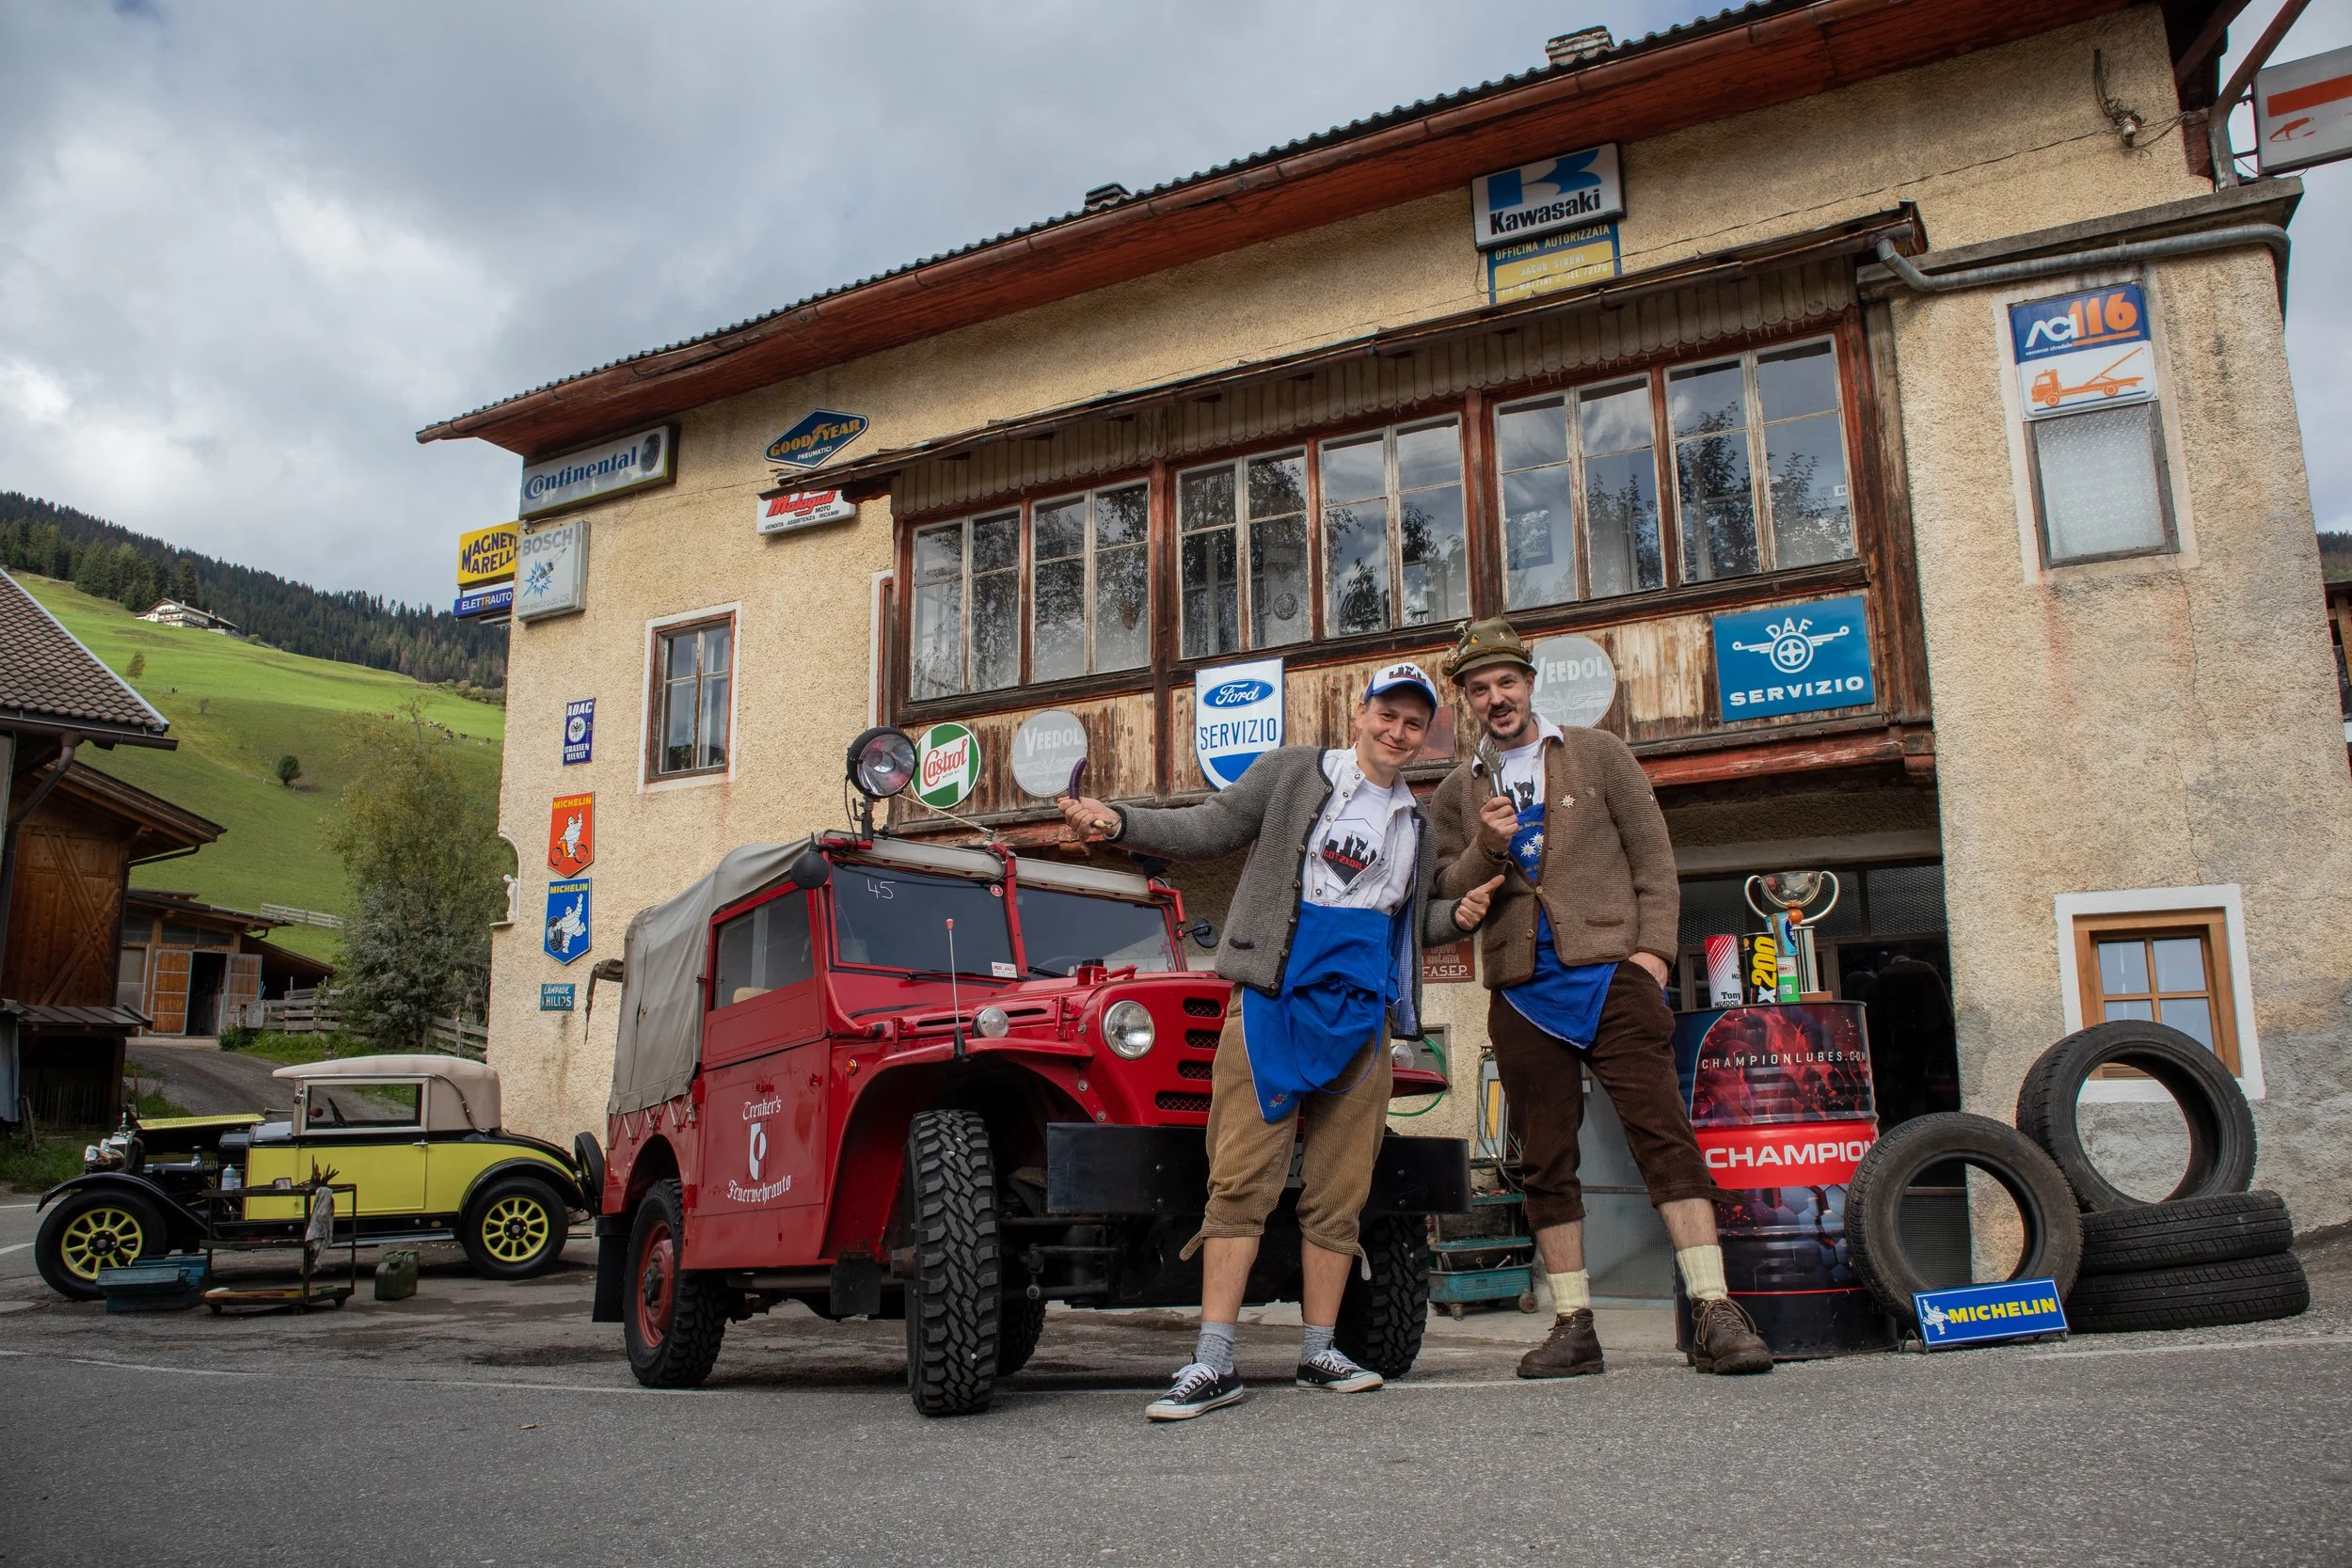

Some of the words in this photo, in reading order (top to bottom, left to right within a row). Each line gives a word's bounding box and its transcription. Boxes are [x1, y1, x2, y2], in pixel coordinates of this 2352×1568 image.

[1490, 188, 1601, 235] Kawasaki
[1495, 242, 1539, 261] OFFICINA
[1544, 224, 1610, 248] AUTORIZZATA
[2068, 292, 2138, 338] 116
[770, 419, 861, 457] GOODYEAR
[797, 446, 833, 461] PNEUMATICI
[524, 446, 637, 500] Continental
[815, 504, 831, 514] MOTO
[765, 521, 785, 531] VENDITA
[787, 515, 816, 526] ASSISTENZA
[818, 510, 840, 519] RICAMBI
[522, 528, 573, 557] BOSCH
[462, 592, 513, 610] ELETTRAUTO
[1765, 617, 1814, 640] DAF
[1215, 683, 1260, 705] Ford
[1729, 676, 1864, 706] SERVIZIO
[566, 702, 593, 717] ADAC
[1024, 726, 1082, 757] VEEDOL
[1200, 718, 1277, 751] SERVIZIO
[566, 751, 586, 761] DIENST
[923, 738, 968, 787] Castrol
[553, 797, 592, 809] MICHELIN
[549, 883, 588, 894] MICHELIN
[866, 879, 896, 899] 45
[1426, 954, 1460, 965] sistema
[544, 986, 569, 995] LAMPADE
[1721, 991, 1741, 1001] Tony
[726, 1174, 791, 1206] Feuerwehrauto
[1947, 1297, 2058, 1323] MICHELIN
